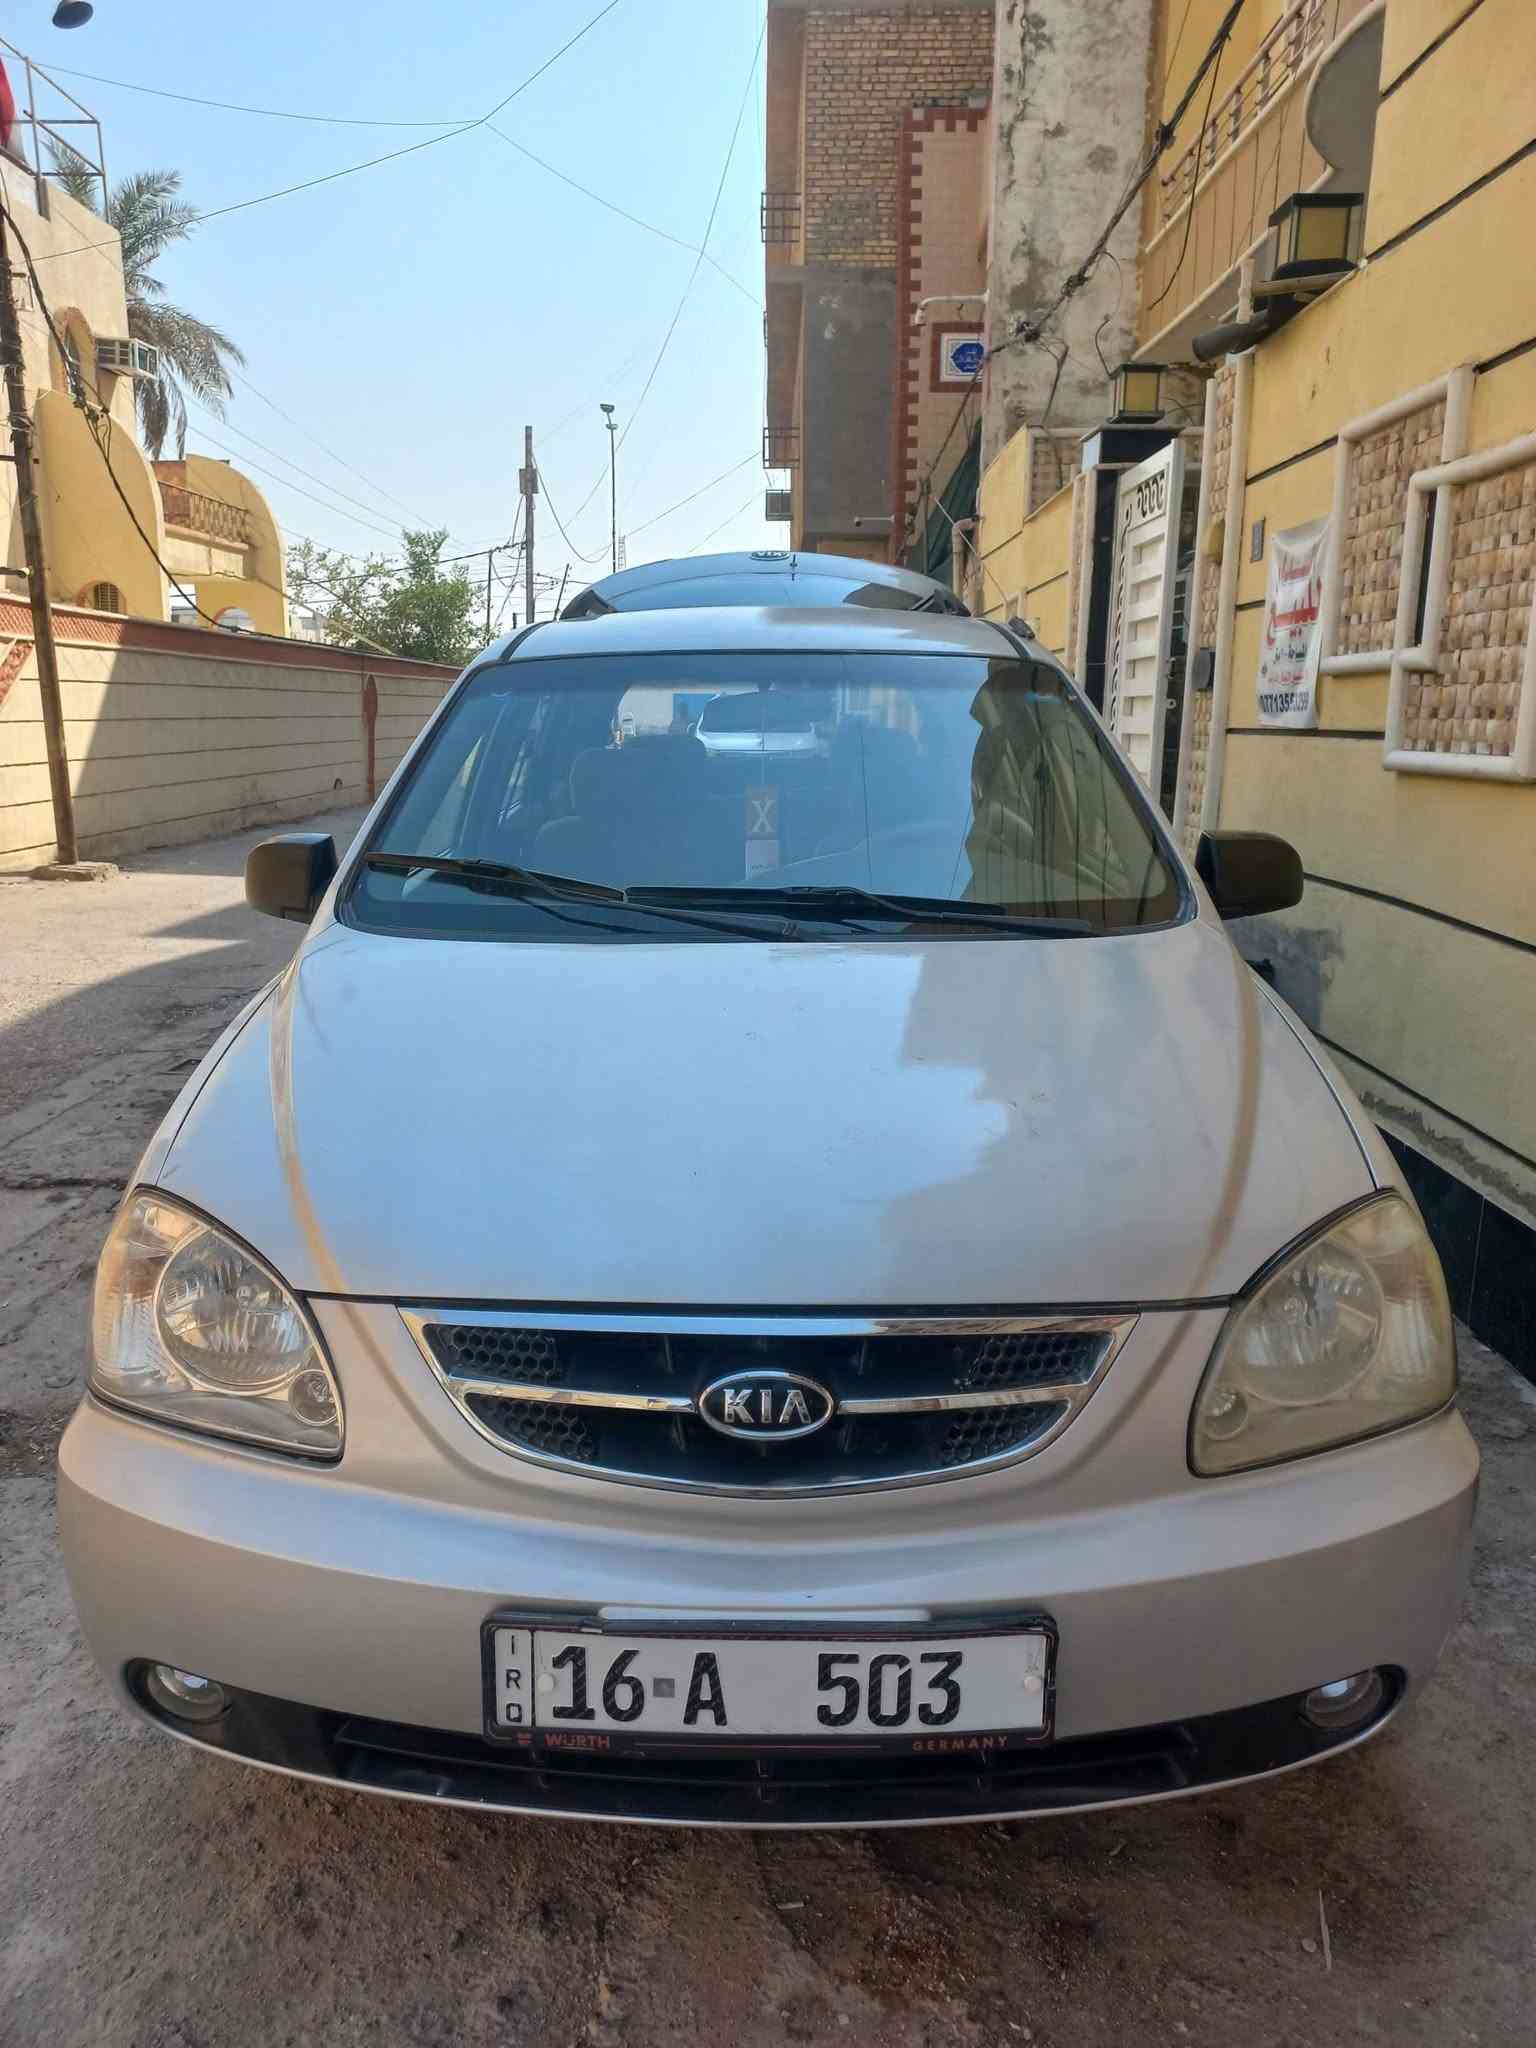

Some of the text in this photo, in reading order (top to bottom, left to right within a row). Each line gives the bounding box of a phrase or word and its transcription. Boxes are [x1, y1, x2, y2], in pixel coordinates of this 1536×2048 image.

[723, 1389, 812, 1424] KIA
[506, 1635, 523, 1722] IRQ
[552, 1645, 963, 1727] 16 A 503
[913, 1735, 1008, 1752] GERMANY
